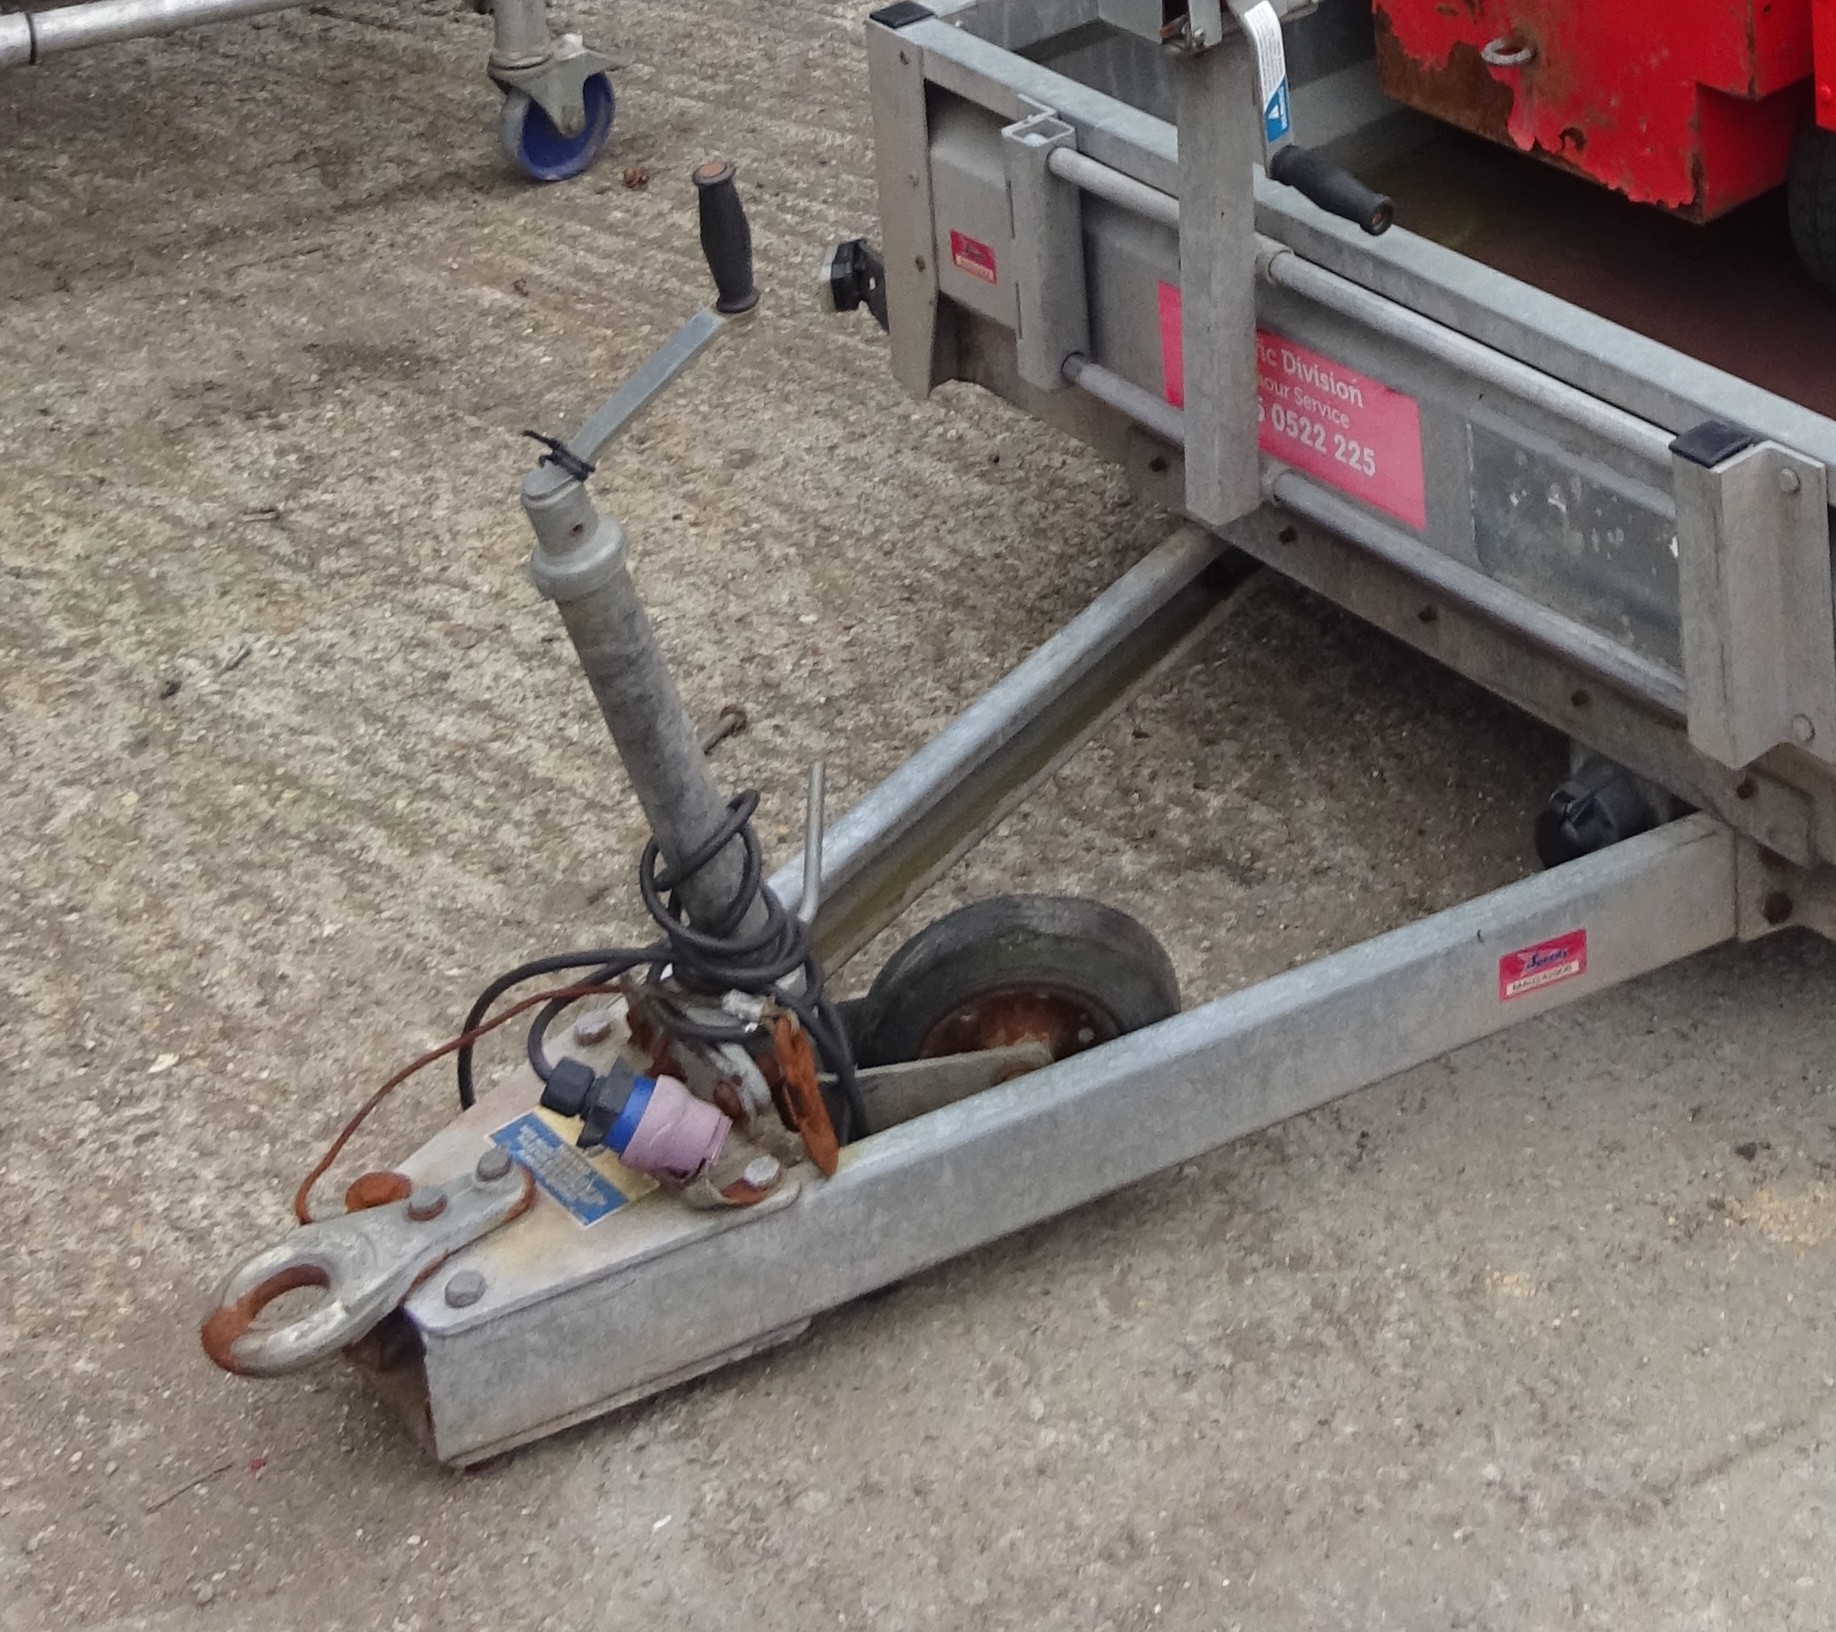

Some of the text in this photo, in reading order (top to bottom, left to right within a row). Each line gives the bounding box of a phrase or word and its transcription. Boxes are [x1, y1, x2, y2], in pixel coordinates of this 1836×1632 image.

[1281, 348, 1364, 409] Division
[1293, 386, 1350, 430] Service
[1271, 402, 1328, 454] 0522
[1333, 433, 1377, 478] 225
